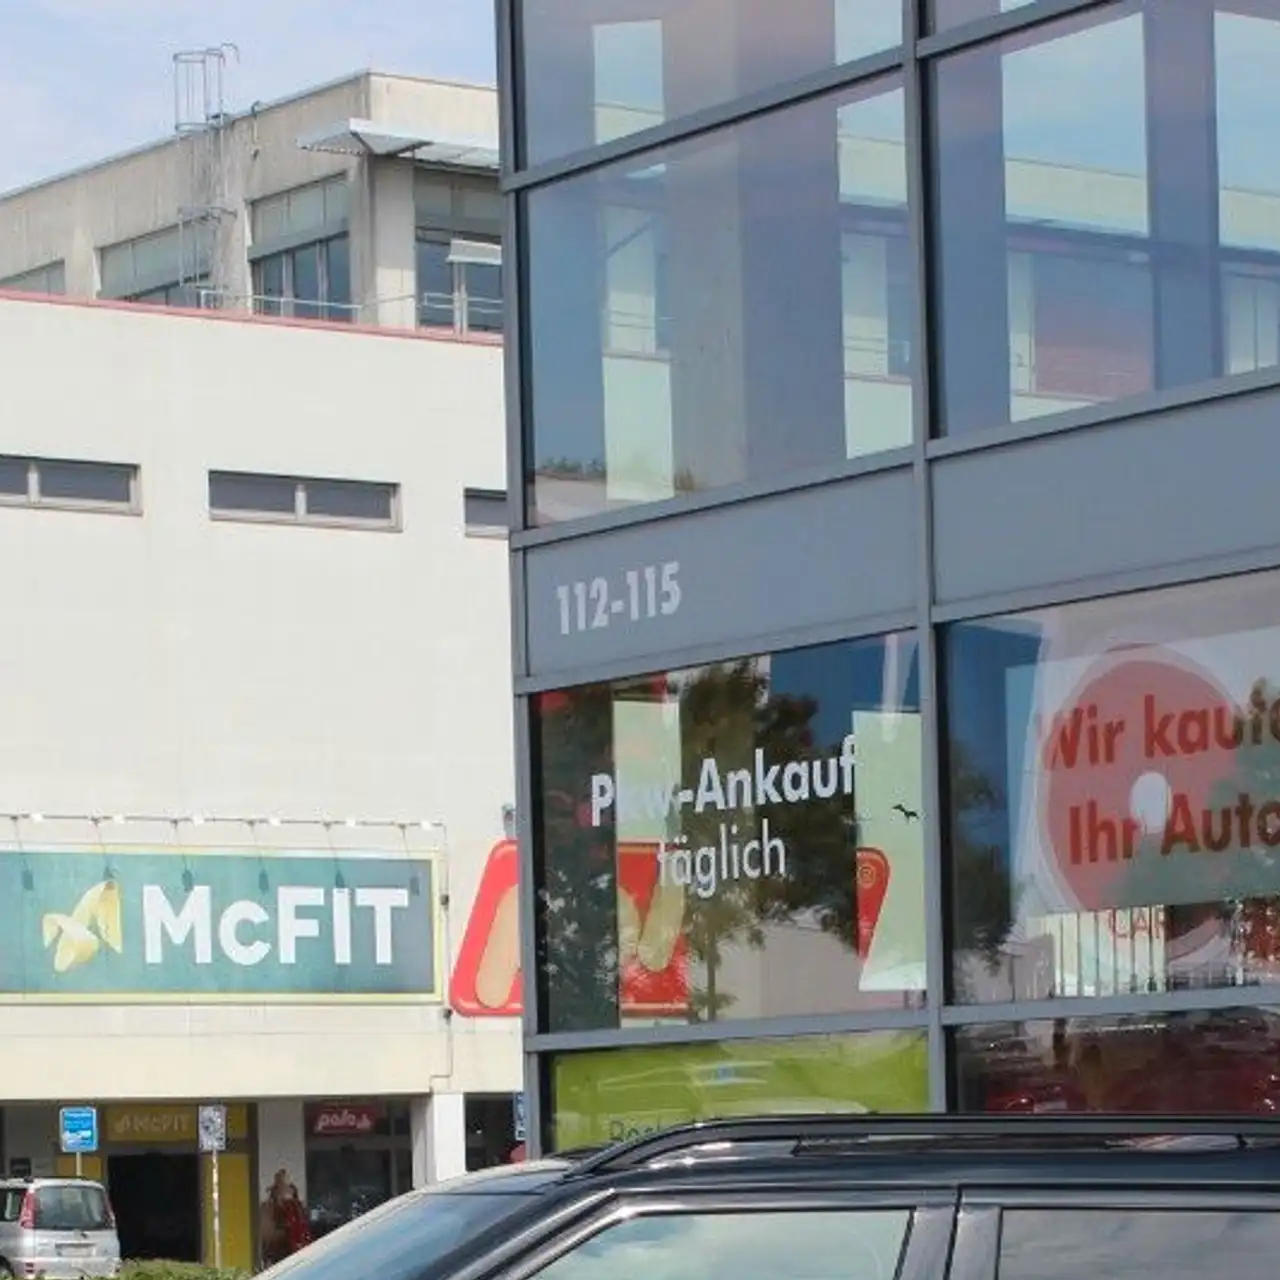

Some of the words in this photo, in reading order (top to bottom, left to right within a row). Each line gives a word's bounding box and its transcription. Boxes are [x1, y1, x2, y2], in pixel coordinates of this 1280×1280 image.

[557, 560, 682, 635] 112-115
[1035, 703, 1125, 770] Wir
[657, 818, 786, 899] täglich
[1069, 799, 1142, 866] Ihr
[142, 885, 410, 966] McFIT
